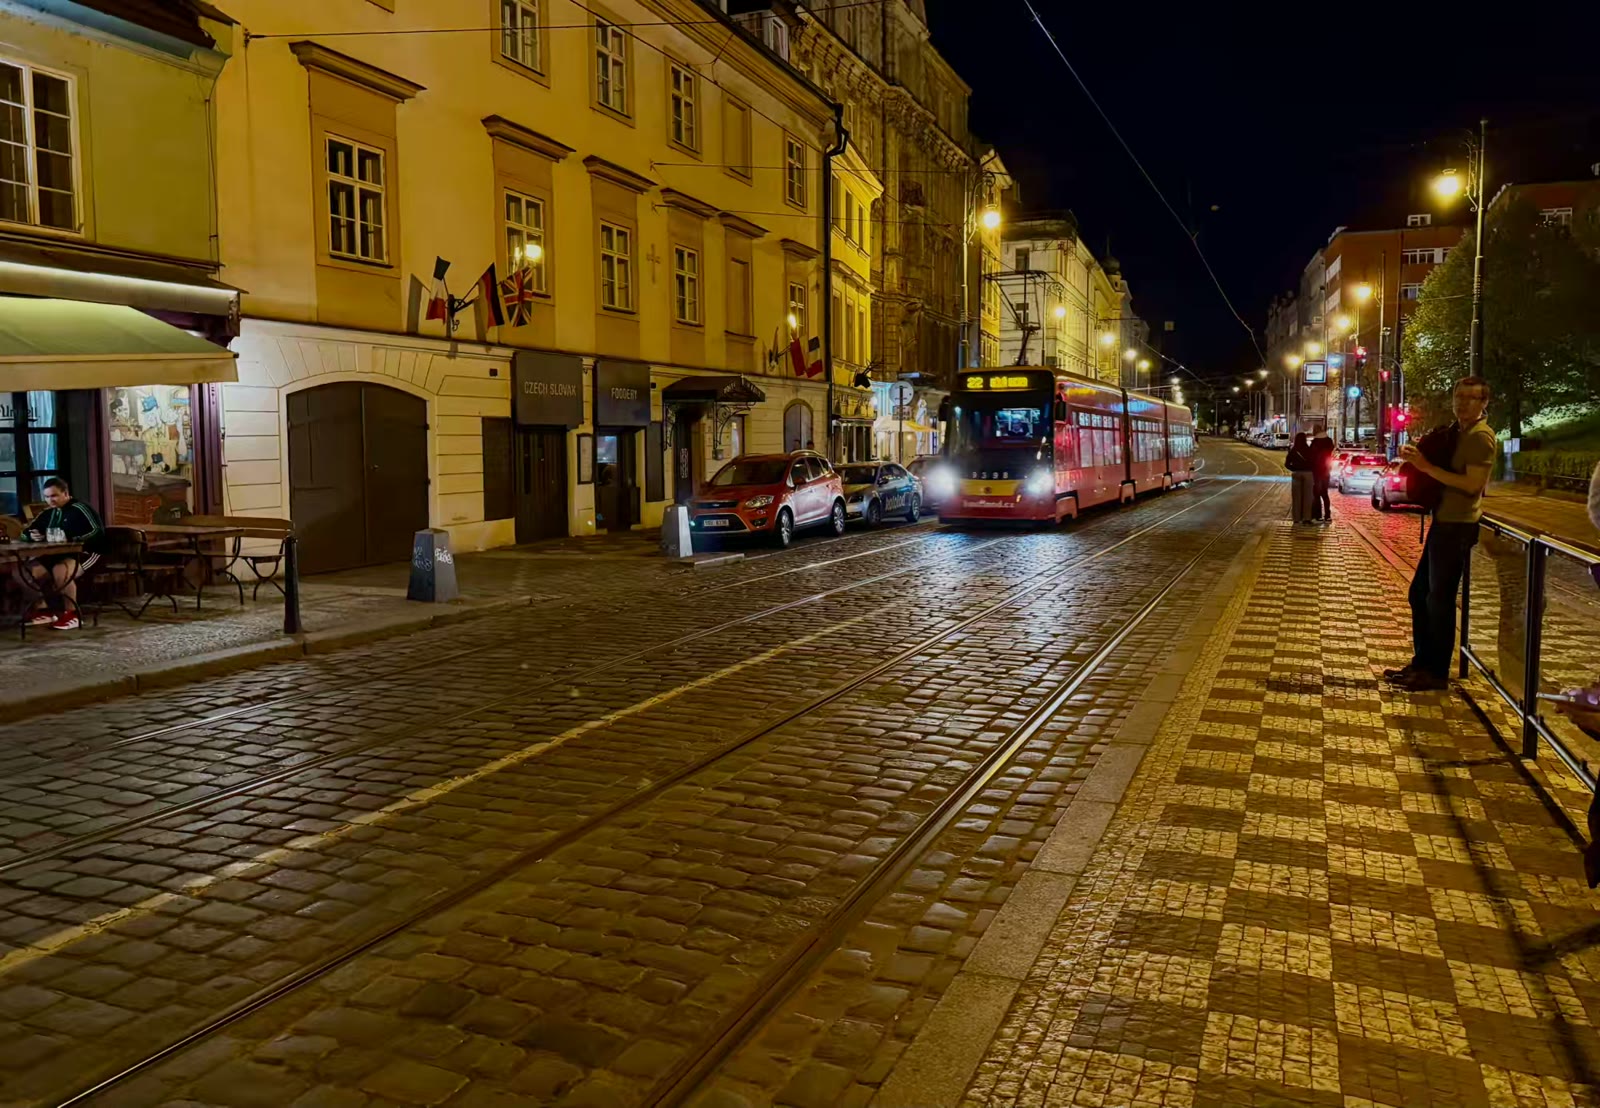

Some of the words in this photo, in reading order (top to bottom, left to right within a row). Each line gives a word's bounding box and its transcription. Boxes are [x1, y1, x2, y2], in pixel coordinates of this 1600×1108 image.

[524, 381, 548, 396] CZECH
[550, 383, 577, 397] SLOVAK
[967, 377, 983, 389] 22
[972, 471, 1009, 479] 9398
